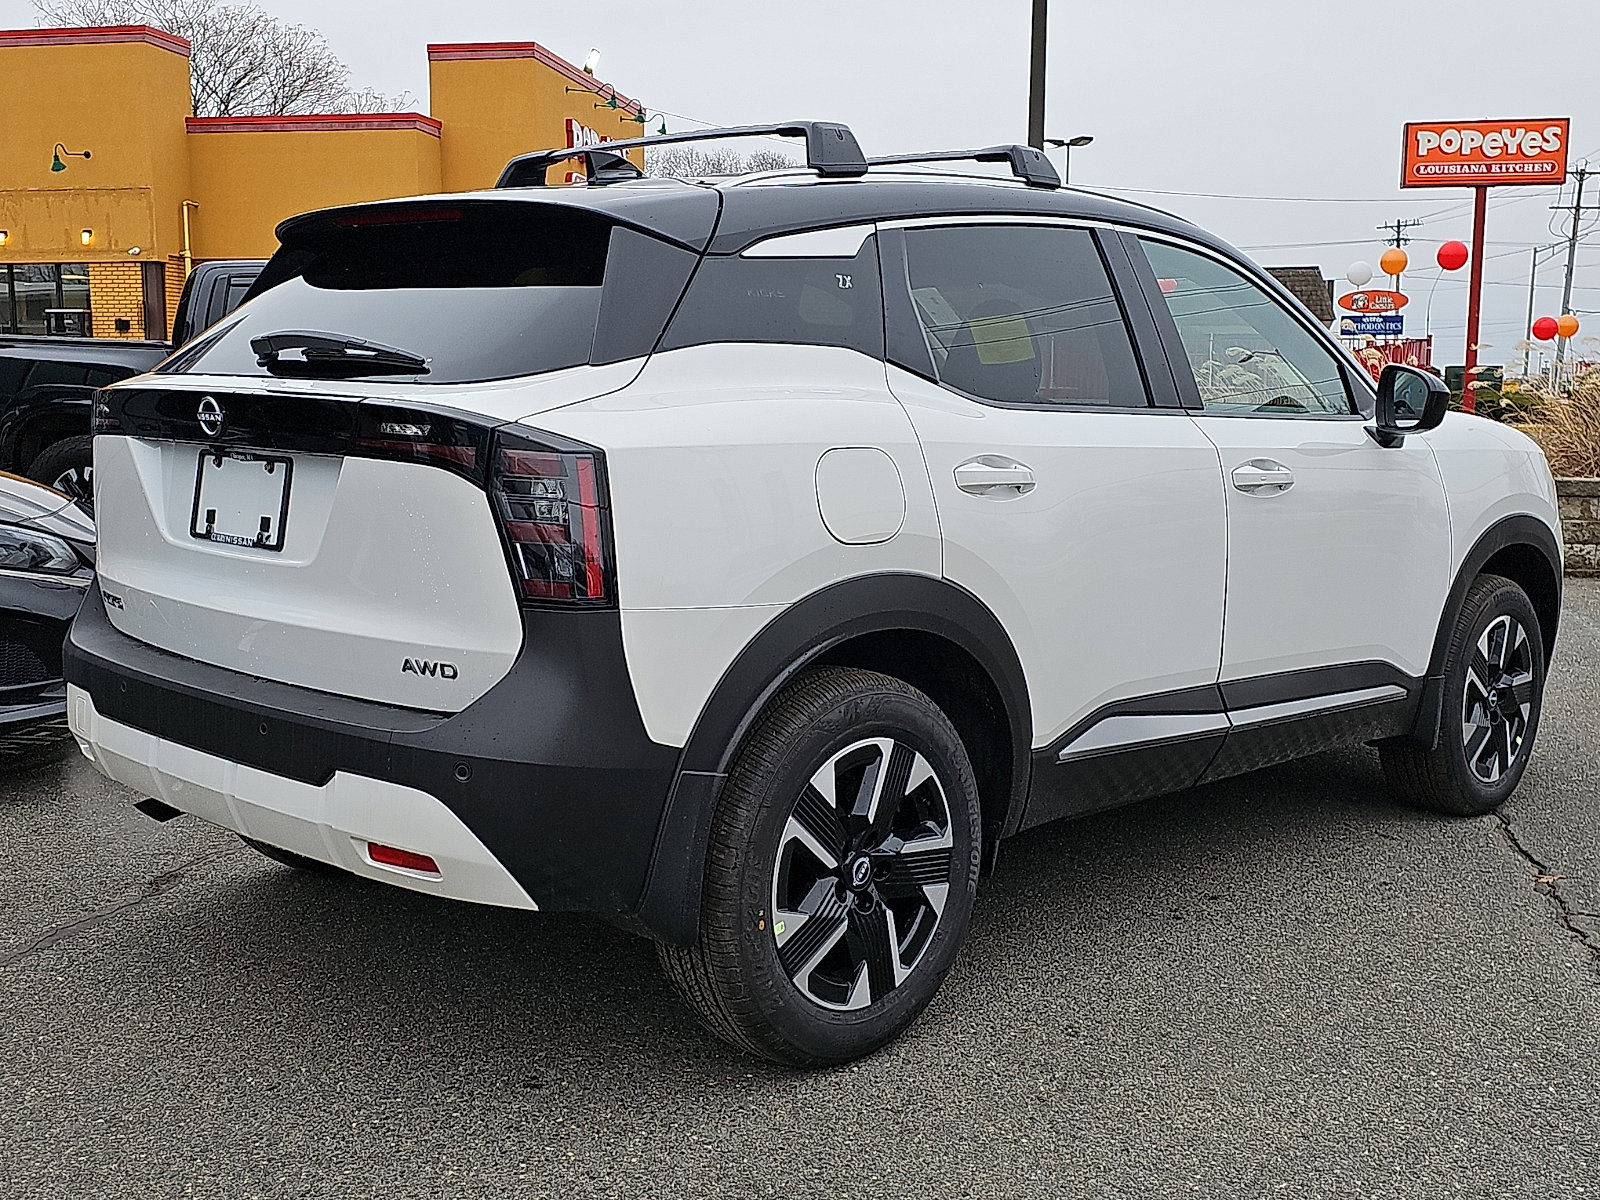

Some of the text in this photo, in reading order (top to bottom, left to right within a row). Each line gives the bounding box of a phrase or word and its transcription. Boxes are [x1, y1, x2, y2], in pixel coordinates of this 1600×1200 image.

[1419, 163, 1553, 174] LOUISIANA KITCHEN
[225, 535, 253, 547] NISSAN
[401, 658, 459, 680] AWD
